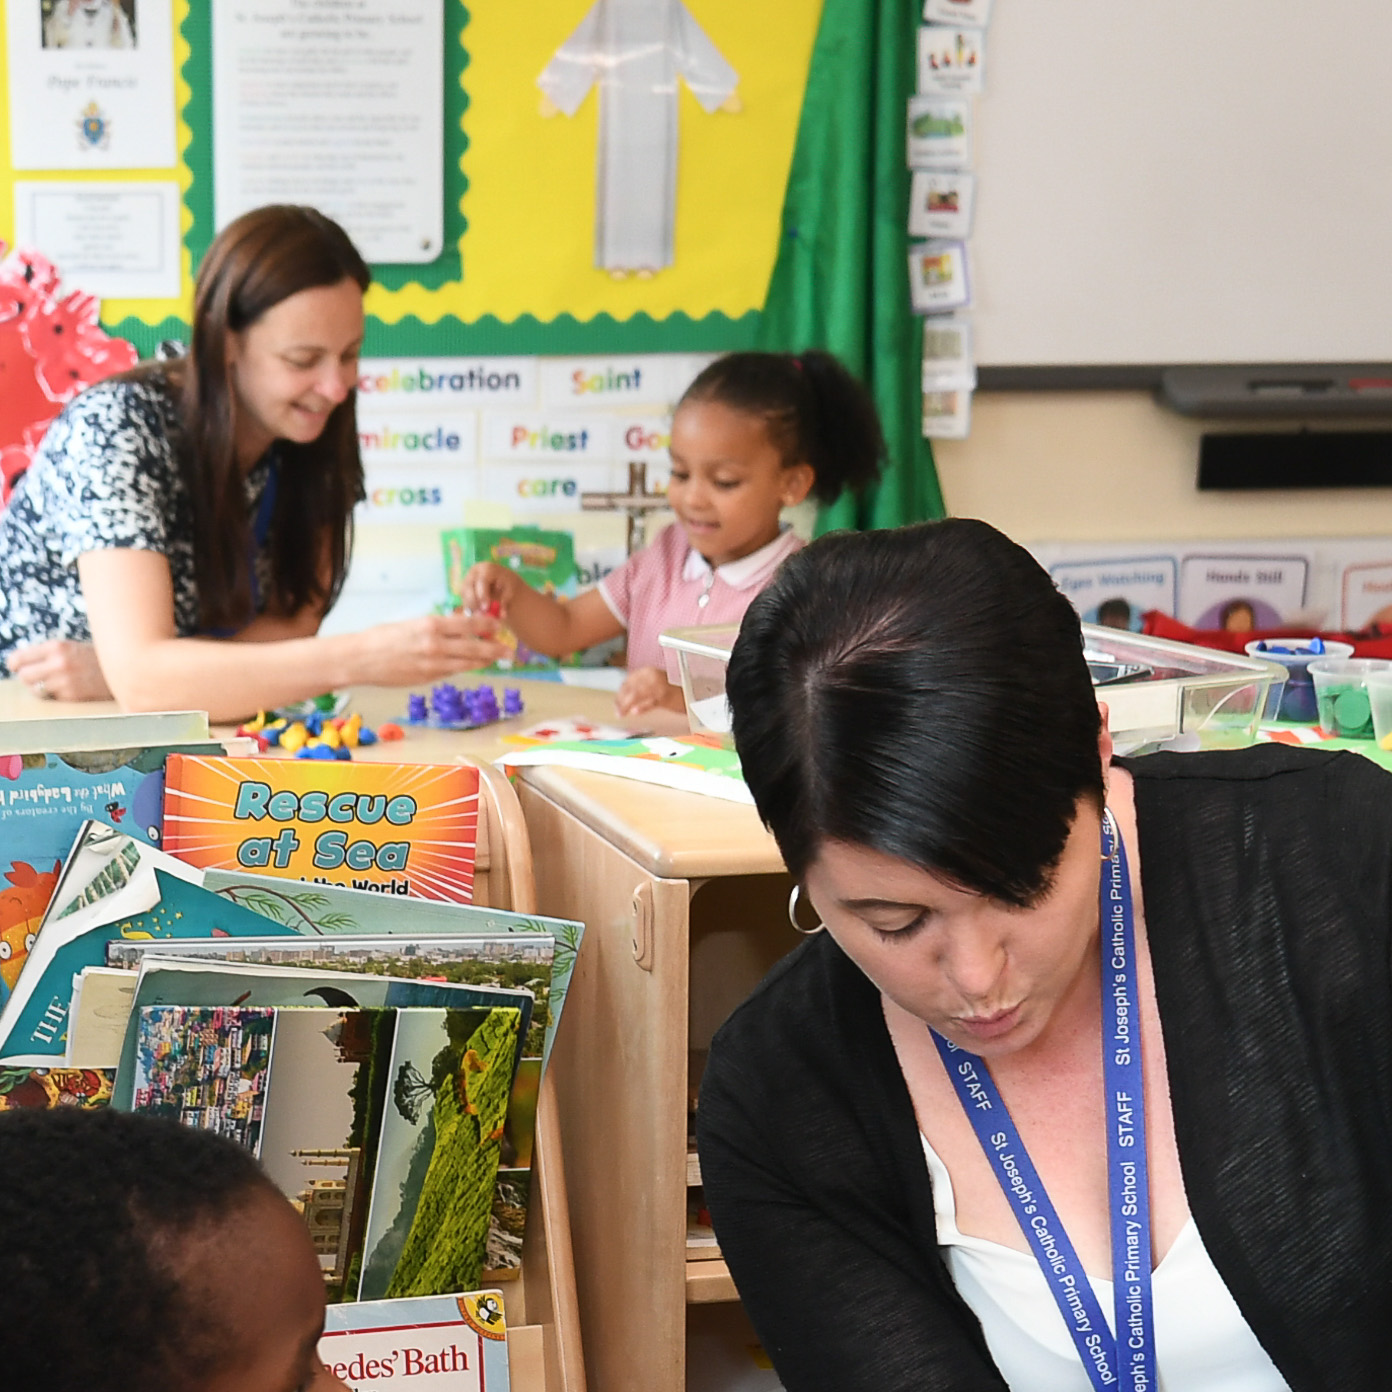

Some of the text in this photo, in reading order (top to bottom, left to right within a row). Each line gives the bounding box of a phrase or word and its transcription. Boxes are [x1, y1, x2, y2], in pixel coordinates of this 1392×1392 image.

[358, 367, 520, 394] celebration
[571, 367, 642, 395] Saint
[512, 426, 589, 450] Priest
[373, 487, 441, 506] cross
[517, 477, 577, 498] care
[1206, 571, 1250, 583] Hands
[9, 784, 72, 806] Ladybird
[92, 782, 127, 801] What
[234, 781, 417, 825] Rescue
[15, 804, 58, 817] creators
[61, 804, 78, 815] the
[237, 828, 411, 871] at Sea
[352, 879, 410, 896] World
[1111, 904, 1126, 970] Catholic
[30, 995, 71, 1044] THE
[1112, 974, 1131, 1045] Joseph's
[1115, 1047, 1131, 1066] St
[1117, 1090, 1134, 1147] STAFF
[1120, 1161, 1138, 1216] School
[958, 1061, 993, 1111] STAFF
[991, 1131, 1009, 1151] St
[1000, 1147, 1038, 1225] Joseph's
[1030, 1215, 1066, 1275] Catholic
[1058, 1273, 1092, 1334] Primary
[1085, 1334, 1116, 1385] School
[1125, 1220, 1142, 1282] Primary
[1127, 1285, 1144, 1349] Catholic
[401, 1344, 471, 1377] Bath
